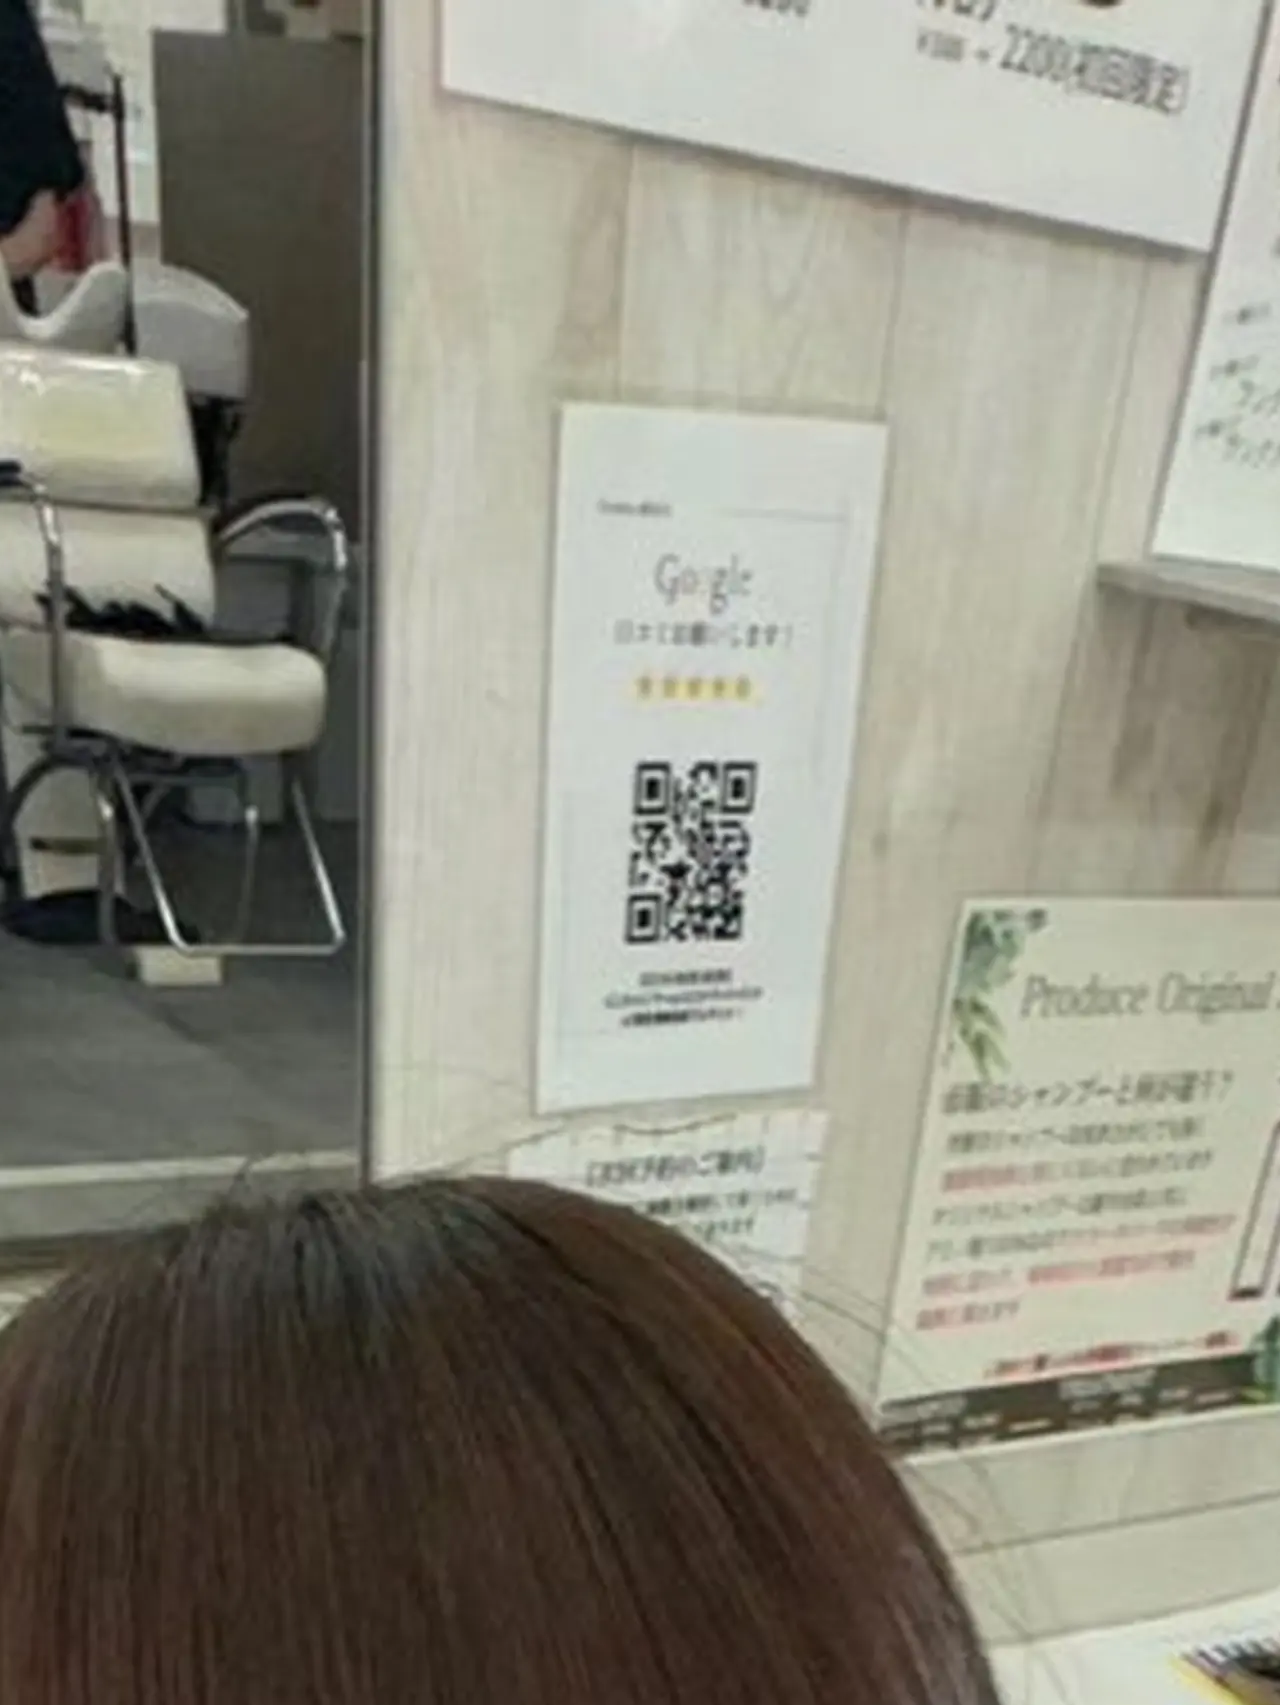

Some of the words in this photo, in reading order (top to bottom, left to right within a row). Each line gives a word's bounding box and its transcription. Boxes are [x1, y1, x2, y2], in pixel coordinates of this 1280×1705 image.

[653, 552, 754, 616] Google
[1021, 972, 1151, 1020] Produce
[1157, 970, 1276, 1025] Original
